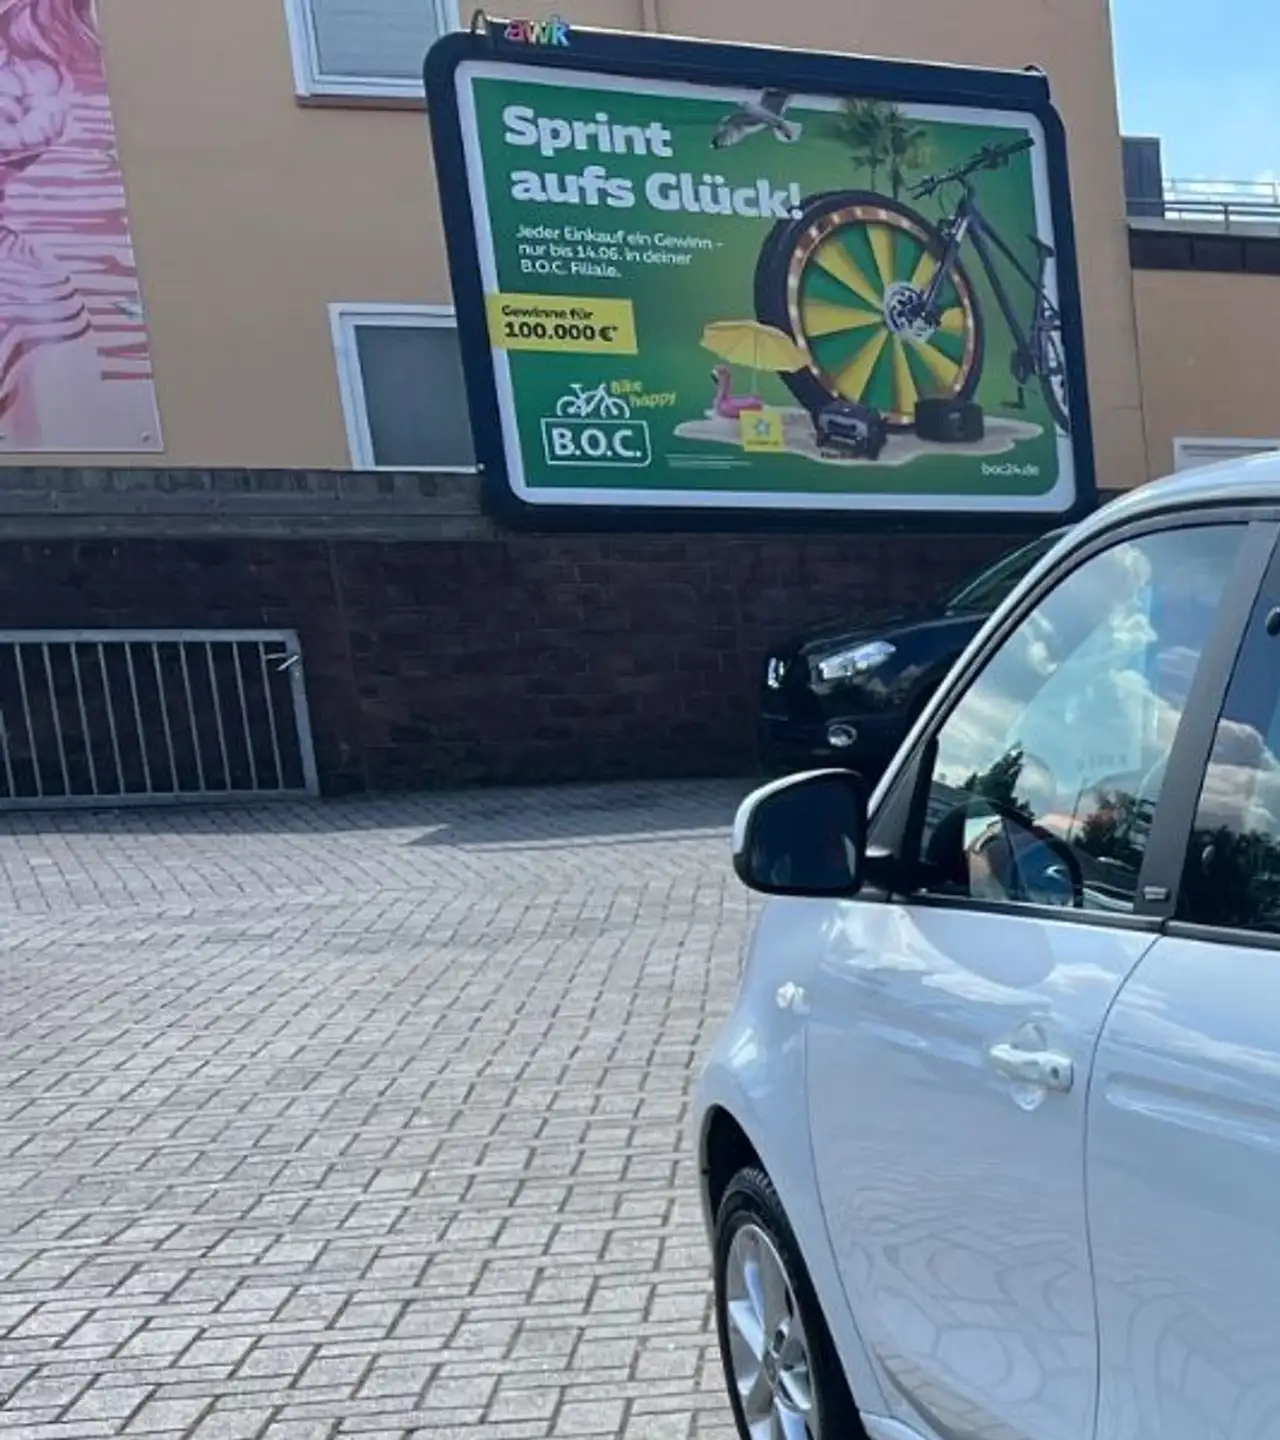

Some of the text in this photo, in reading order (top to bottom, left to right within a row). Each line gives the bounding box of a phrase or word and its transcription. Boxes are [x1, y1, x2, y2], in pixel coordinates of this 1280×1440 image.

[502, 104, 673, 157] Sprint
[511, 165, 802, 220] aufs Glück!
[516, 224, 560, 239] Jeder
[564, 226, 625, 244] Einkauf
[627, 232, 650, 245] ein
[654, 233, 712, 249] Gewinn
[518, 243, 548, 256] nur
[550, 244, 572, 258] bis
[625, 248, 639, 262] in
[644, 251, 692, 266] deiner
[501, 304, 594, 321] Gewinne für
[552, 428, 641, 457] B.O.C.
